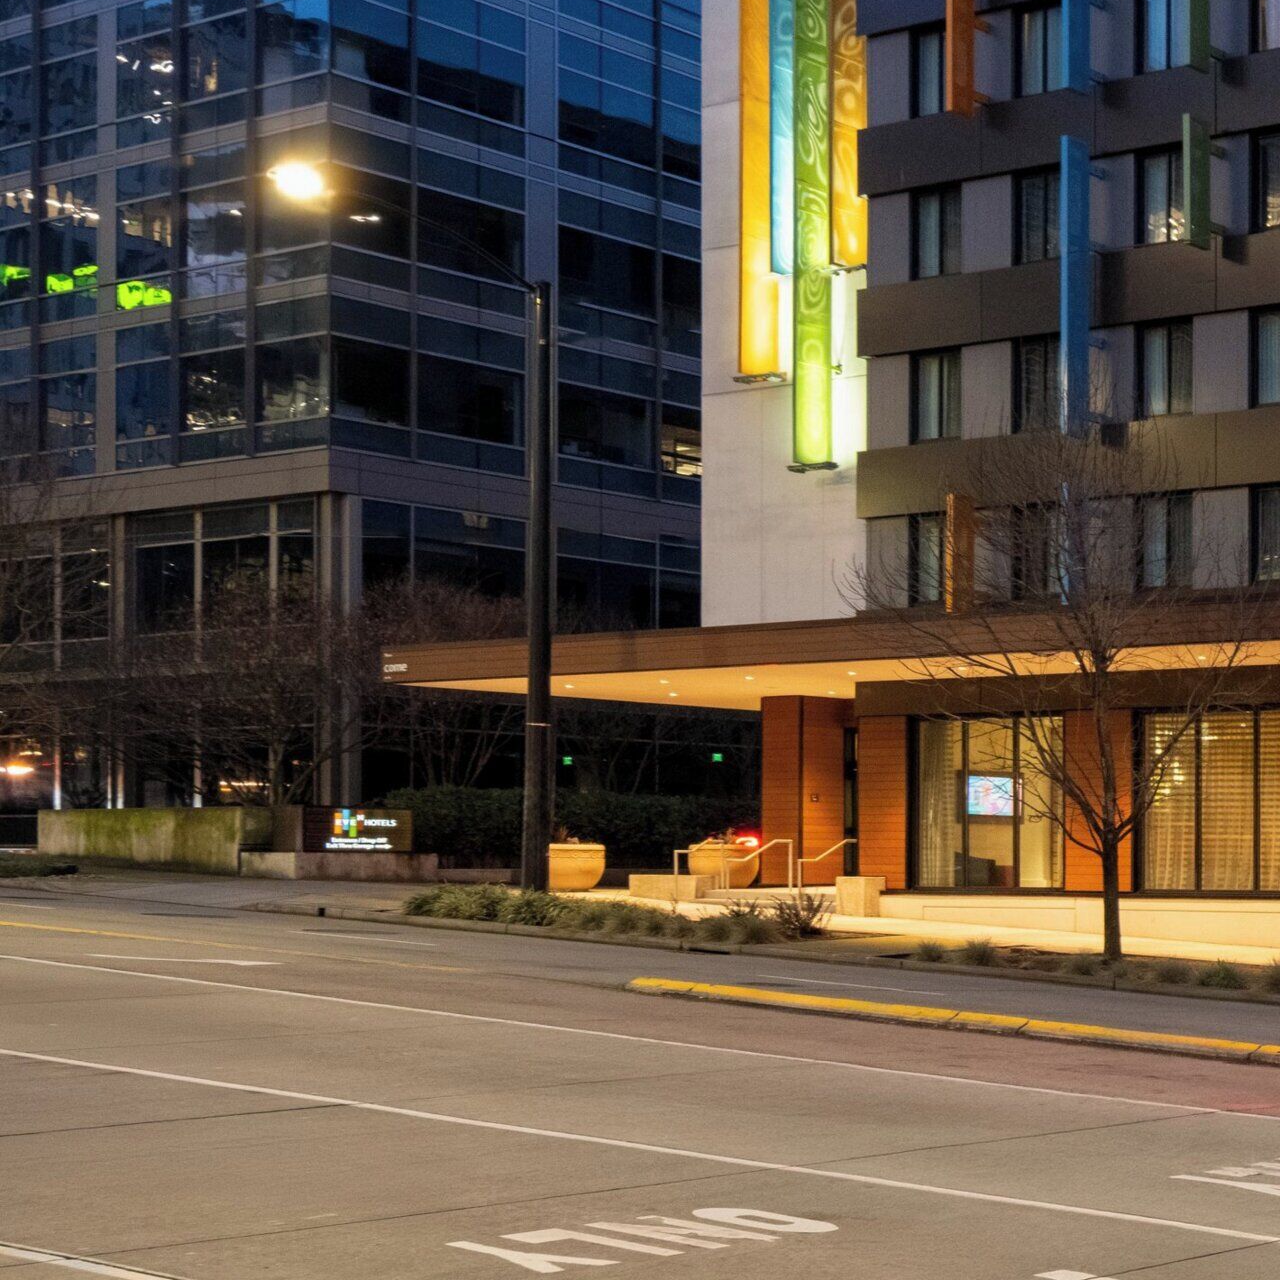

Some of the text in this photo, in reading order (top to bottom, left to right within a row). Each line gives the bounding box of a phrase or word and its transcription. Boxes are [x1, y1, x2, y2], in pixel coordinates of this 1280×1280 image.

[335, 814, 397, 827] EVEN HOTELS
[444, 1207, 839, 1273] ONLY
